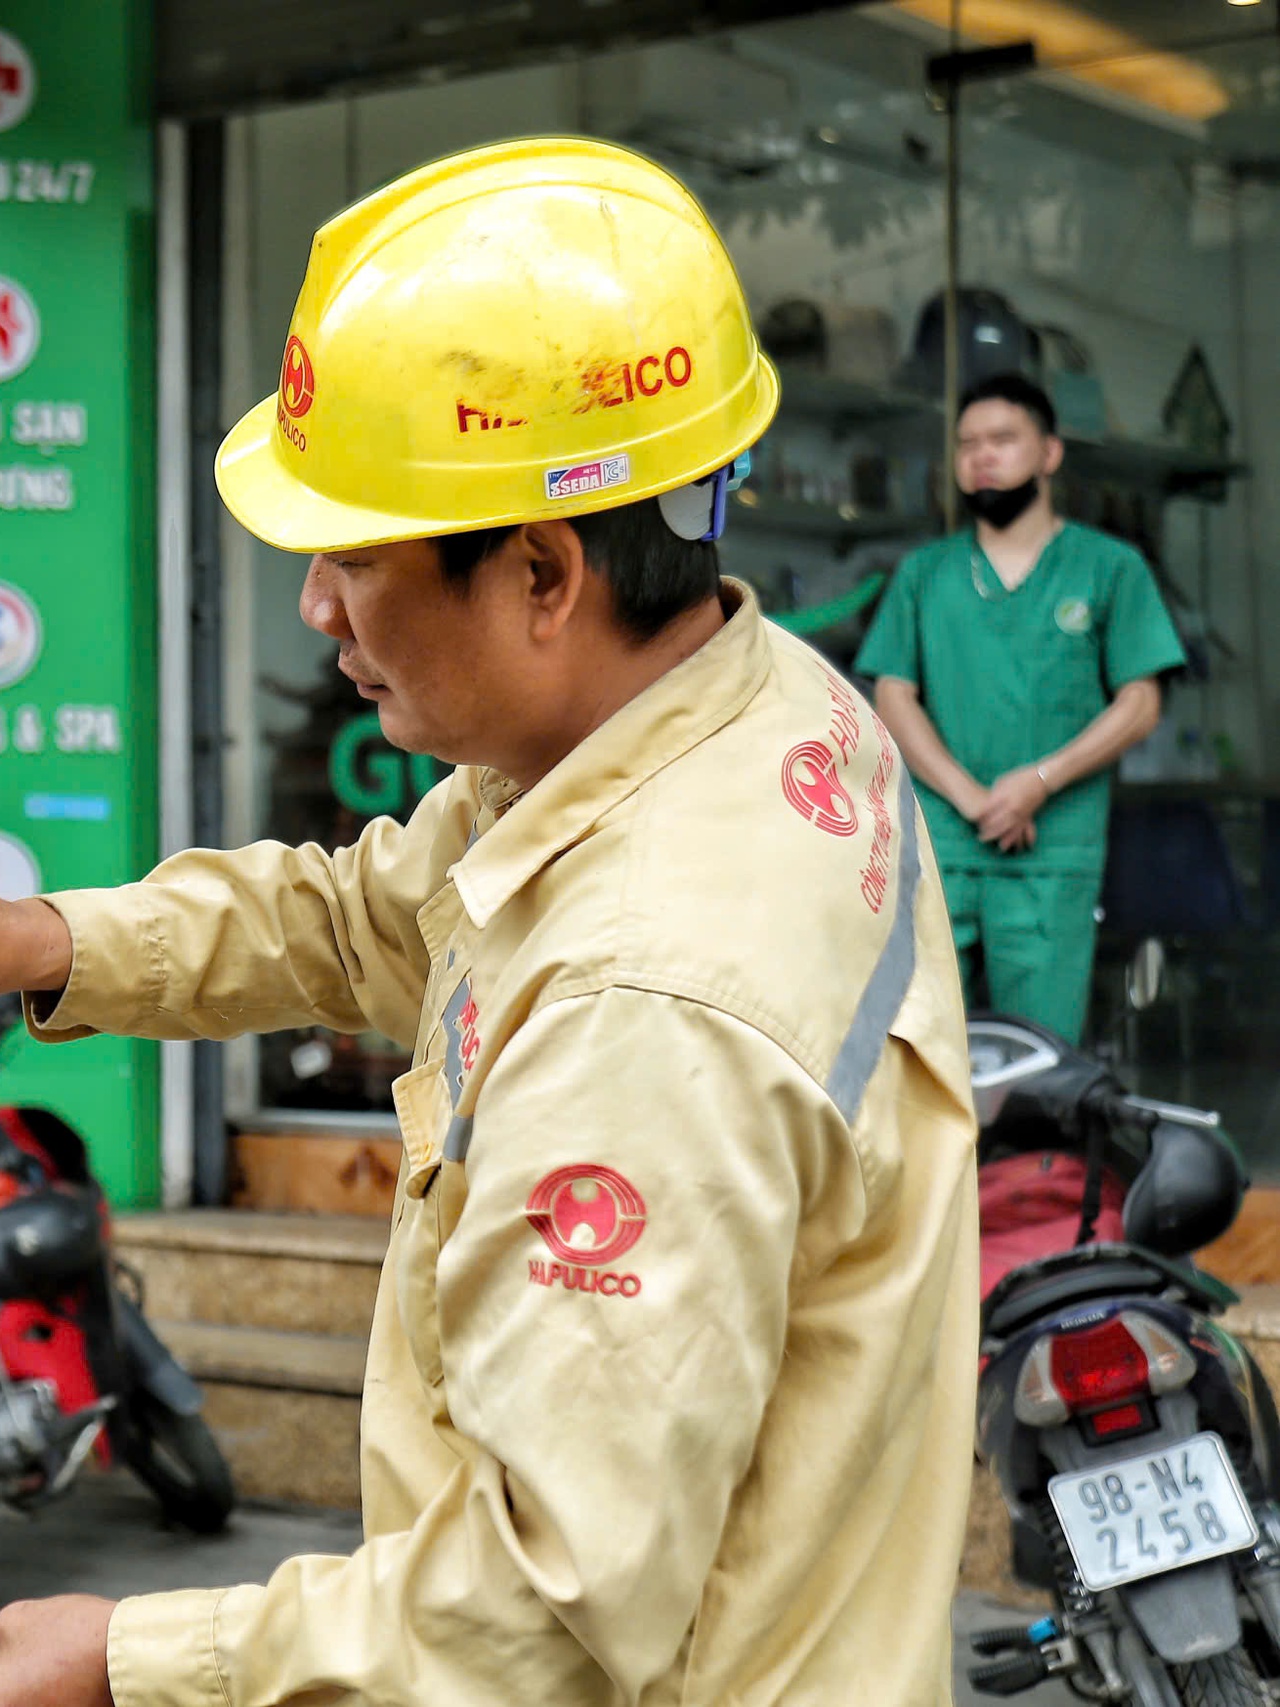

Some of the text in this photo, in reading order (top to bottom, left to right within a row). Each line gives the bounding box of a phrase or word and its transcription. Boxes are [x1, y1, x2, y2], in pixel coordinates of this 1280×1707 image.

[54, 706, 120, 752] SPA
[1078, 1452, 1204, 1524] 98-N4
[1096, 1500, 1227, 1575] 2458
